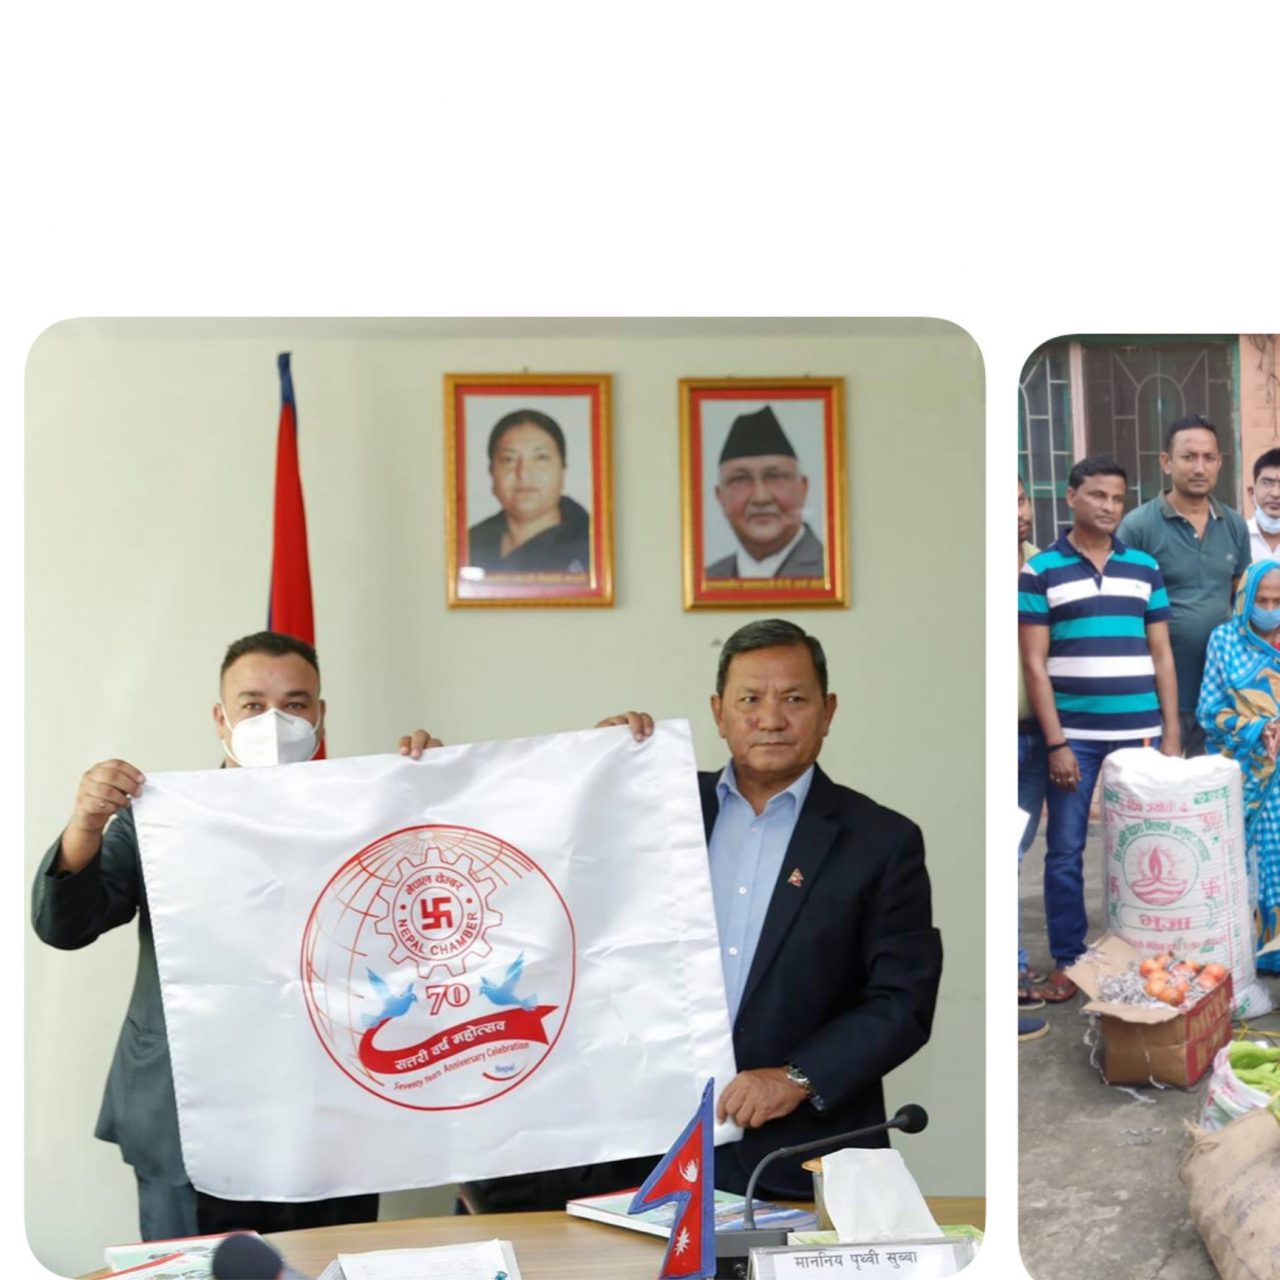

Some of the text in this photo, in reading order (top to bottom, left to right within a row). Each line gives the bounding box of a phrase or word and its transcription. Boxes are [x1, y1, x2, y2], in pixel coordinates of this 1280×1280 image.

[398, 912, 478, 956] NEPAL CHAMBER
[425, 983, 471, 1016] 70
[451, 1020, 507, 1045] महोत्सव
[393, 1079, 423, 1090] Seventy
[443, 1053, 486, 1073] Anniversary
[486, 1041, 530, 1058] Celebration
[793, 1248, 919, 1271] माननिय पृथ्वी सुब्बा
